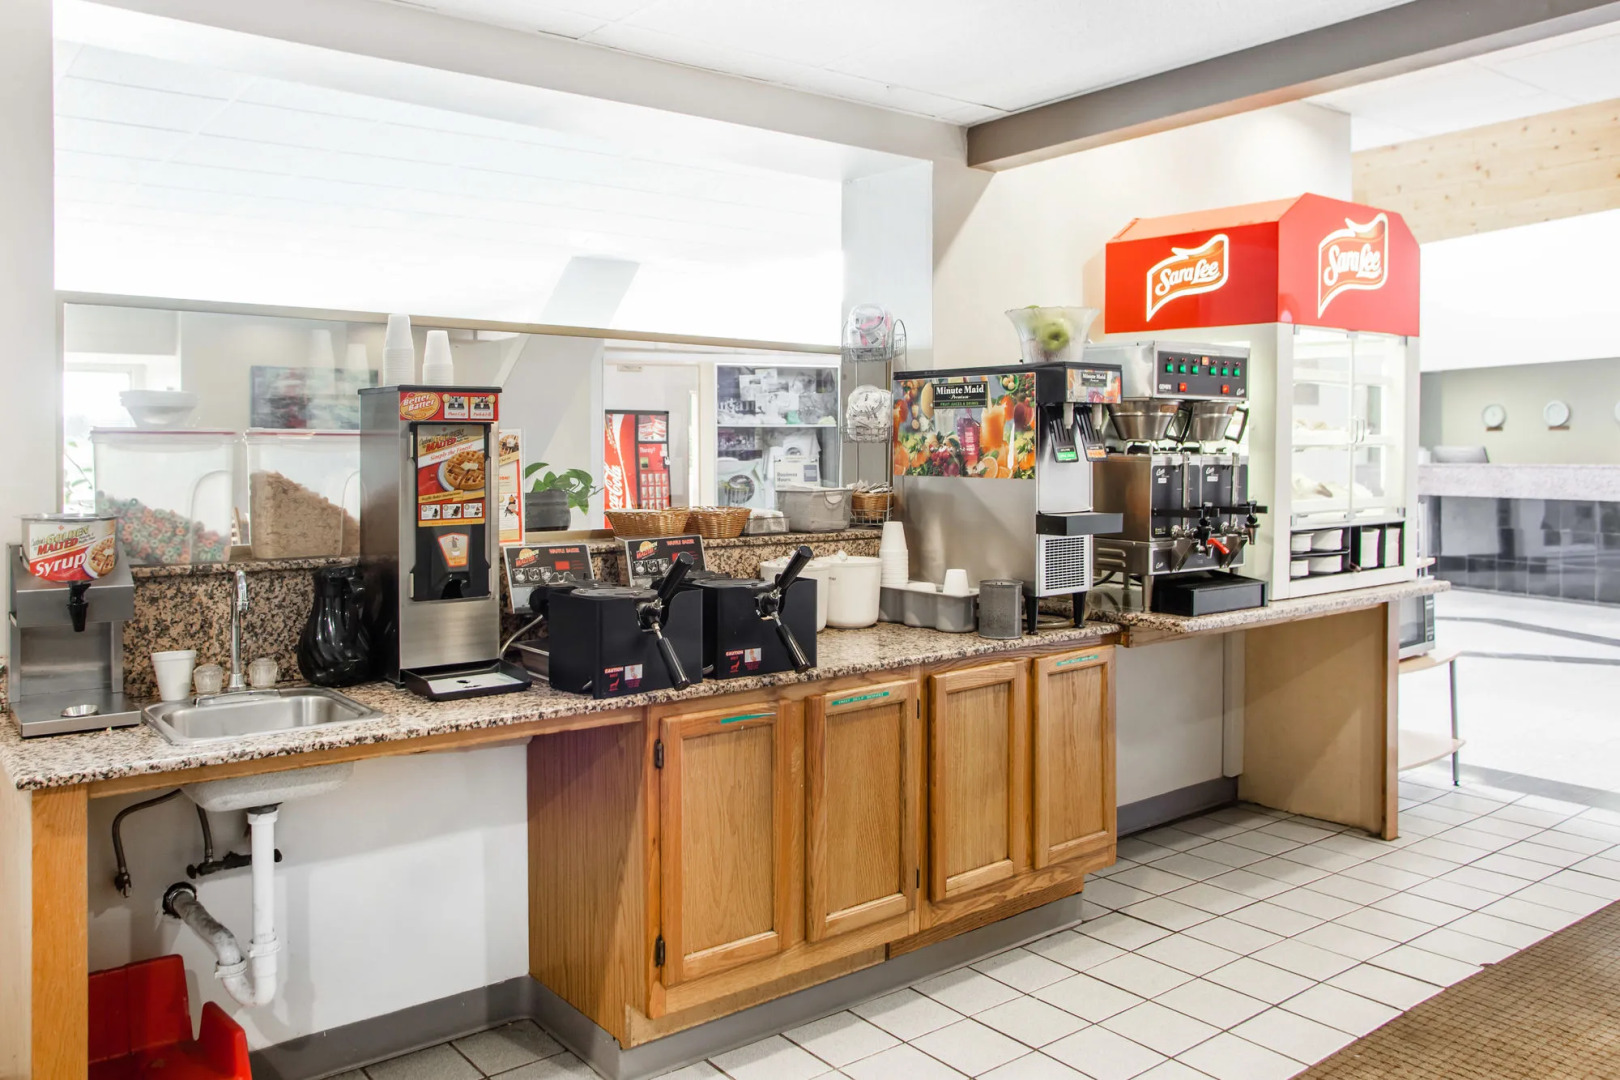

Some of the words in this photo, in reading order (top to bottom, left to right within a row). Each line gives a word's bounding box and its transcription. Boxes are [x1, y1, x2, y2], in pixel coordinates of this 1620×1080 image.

[1323, 244, 1360, 287] Sara
[1356, 243, 1382, 279] Lee
[1154, 267, 1194, 296] Sara
[1190, 258, 1221, 285] Lee
[936, 386, 963, 395] Minute
[964, 384, 985, 394] Maid
[402, 394, 430, 407] Better
[408, 399, 436, 412] Batter
[425, 437, 457, 453] MALTED
[37, 537, 79, 556] MALTED
[35, 552, 86, 578] Syrup
